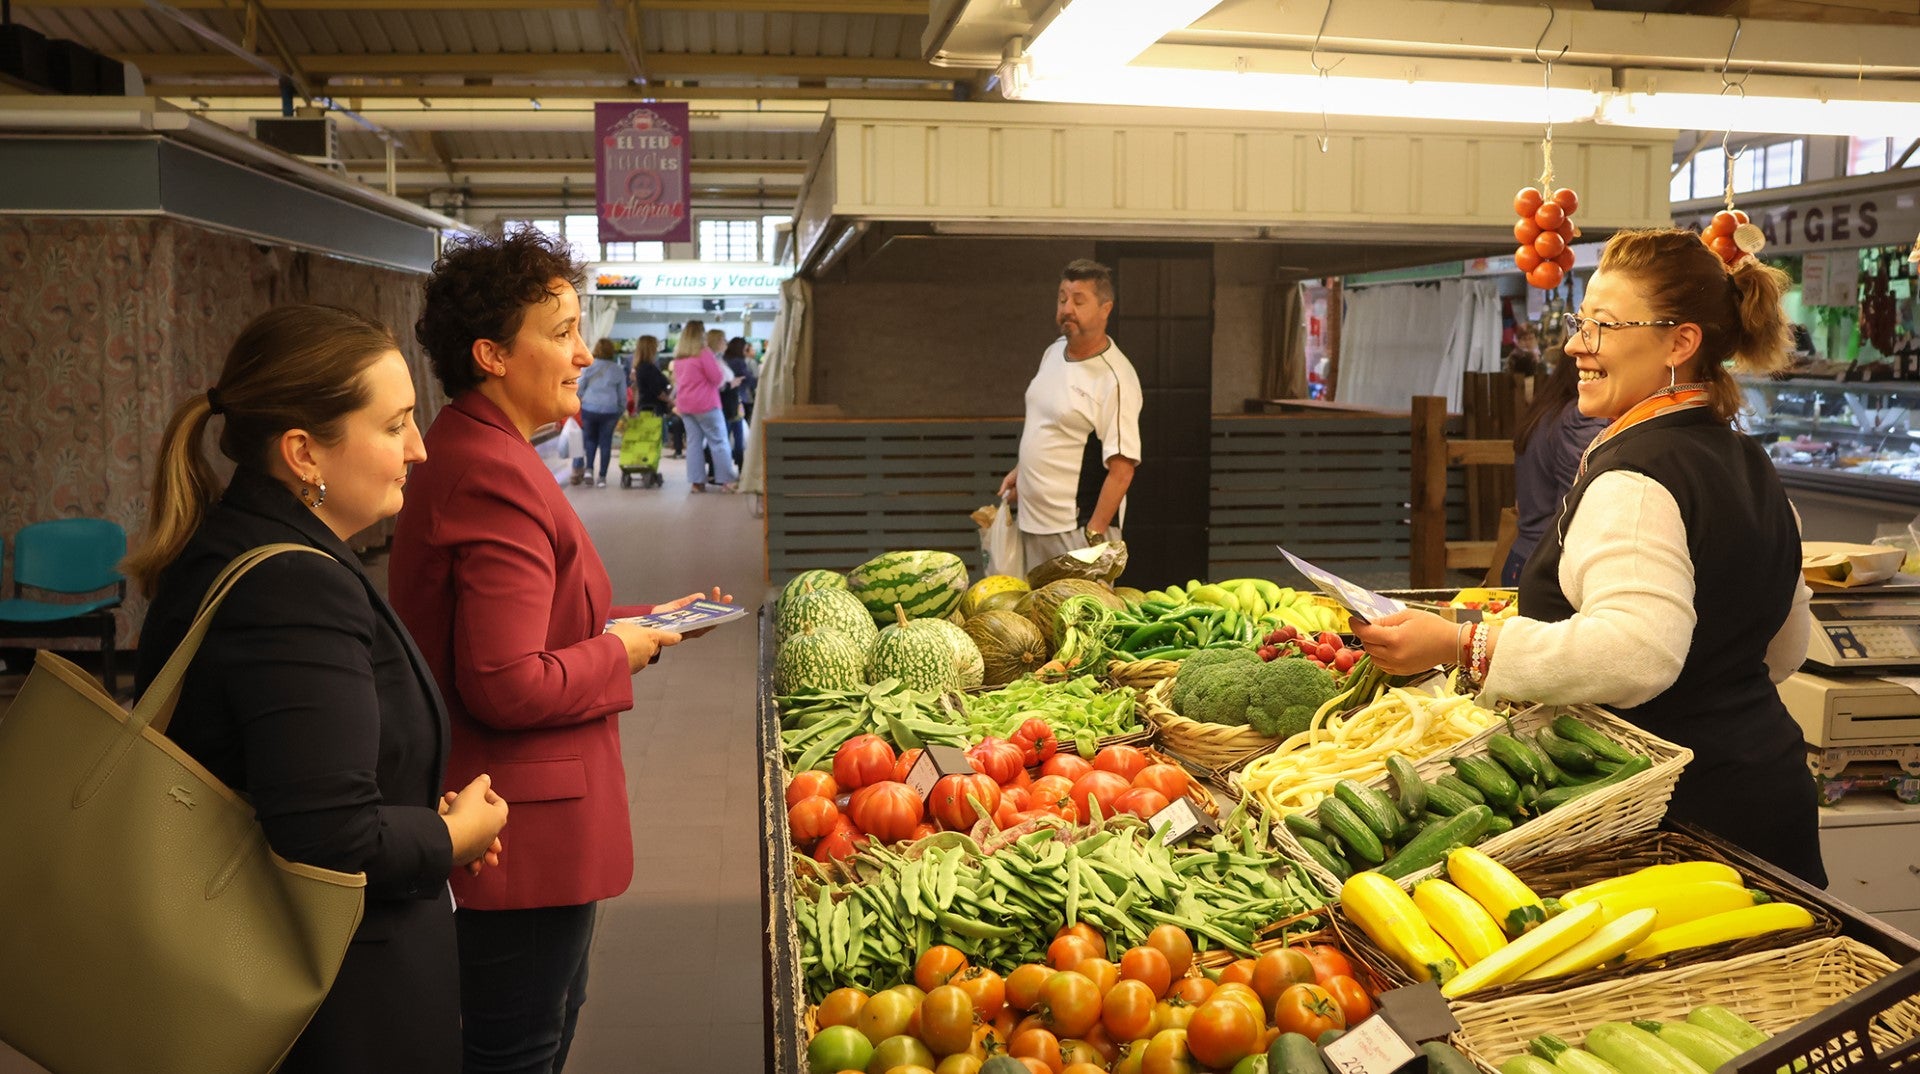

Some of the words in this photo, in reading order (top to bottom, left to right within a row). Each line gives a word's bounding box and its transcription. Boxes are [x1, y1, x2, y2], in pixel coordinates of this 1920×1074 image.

[616, 135, 634, 149] EL
[638, 135, 670, 149] TEU
[655, 274, 707, 288] Frutas
[712, 275, 723, 290] y
